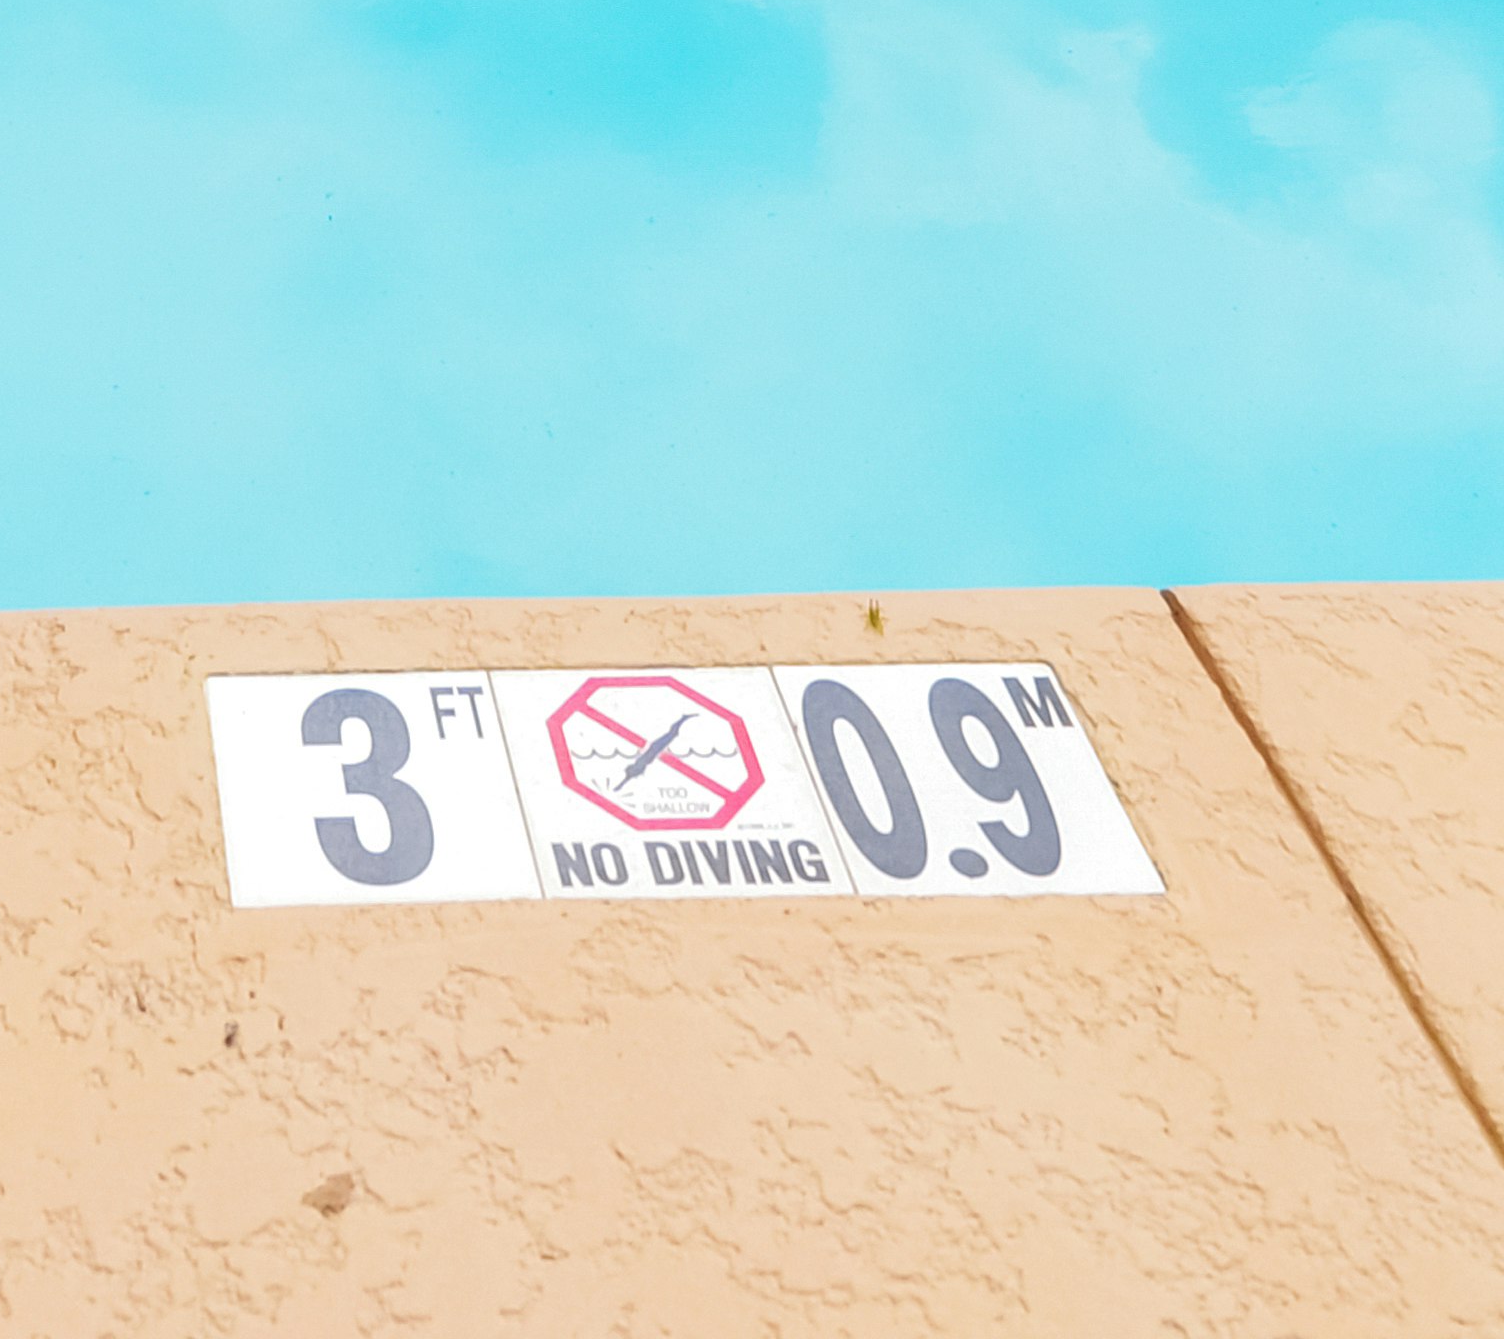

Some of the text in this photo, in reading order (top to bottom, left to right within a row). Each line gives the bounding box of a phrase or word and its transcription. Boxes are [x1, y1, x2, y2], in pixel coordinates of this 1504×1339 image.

[300, 676, 1074, 886] 3 FT 0.9 M
[657, 786, 688, 799] TOO
[643, 802, 710, 814] SHALLOW
[550, 838, 831, 887] NO DIVING
